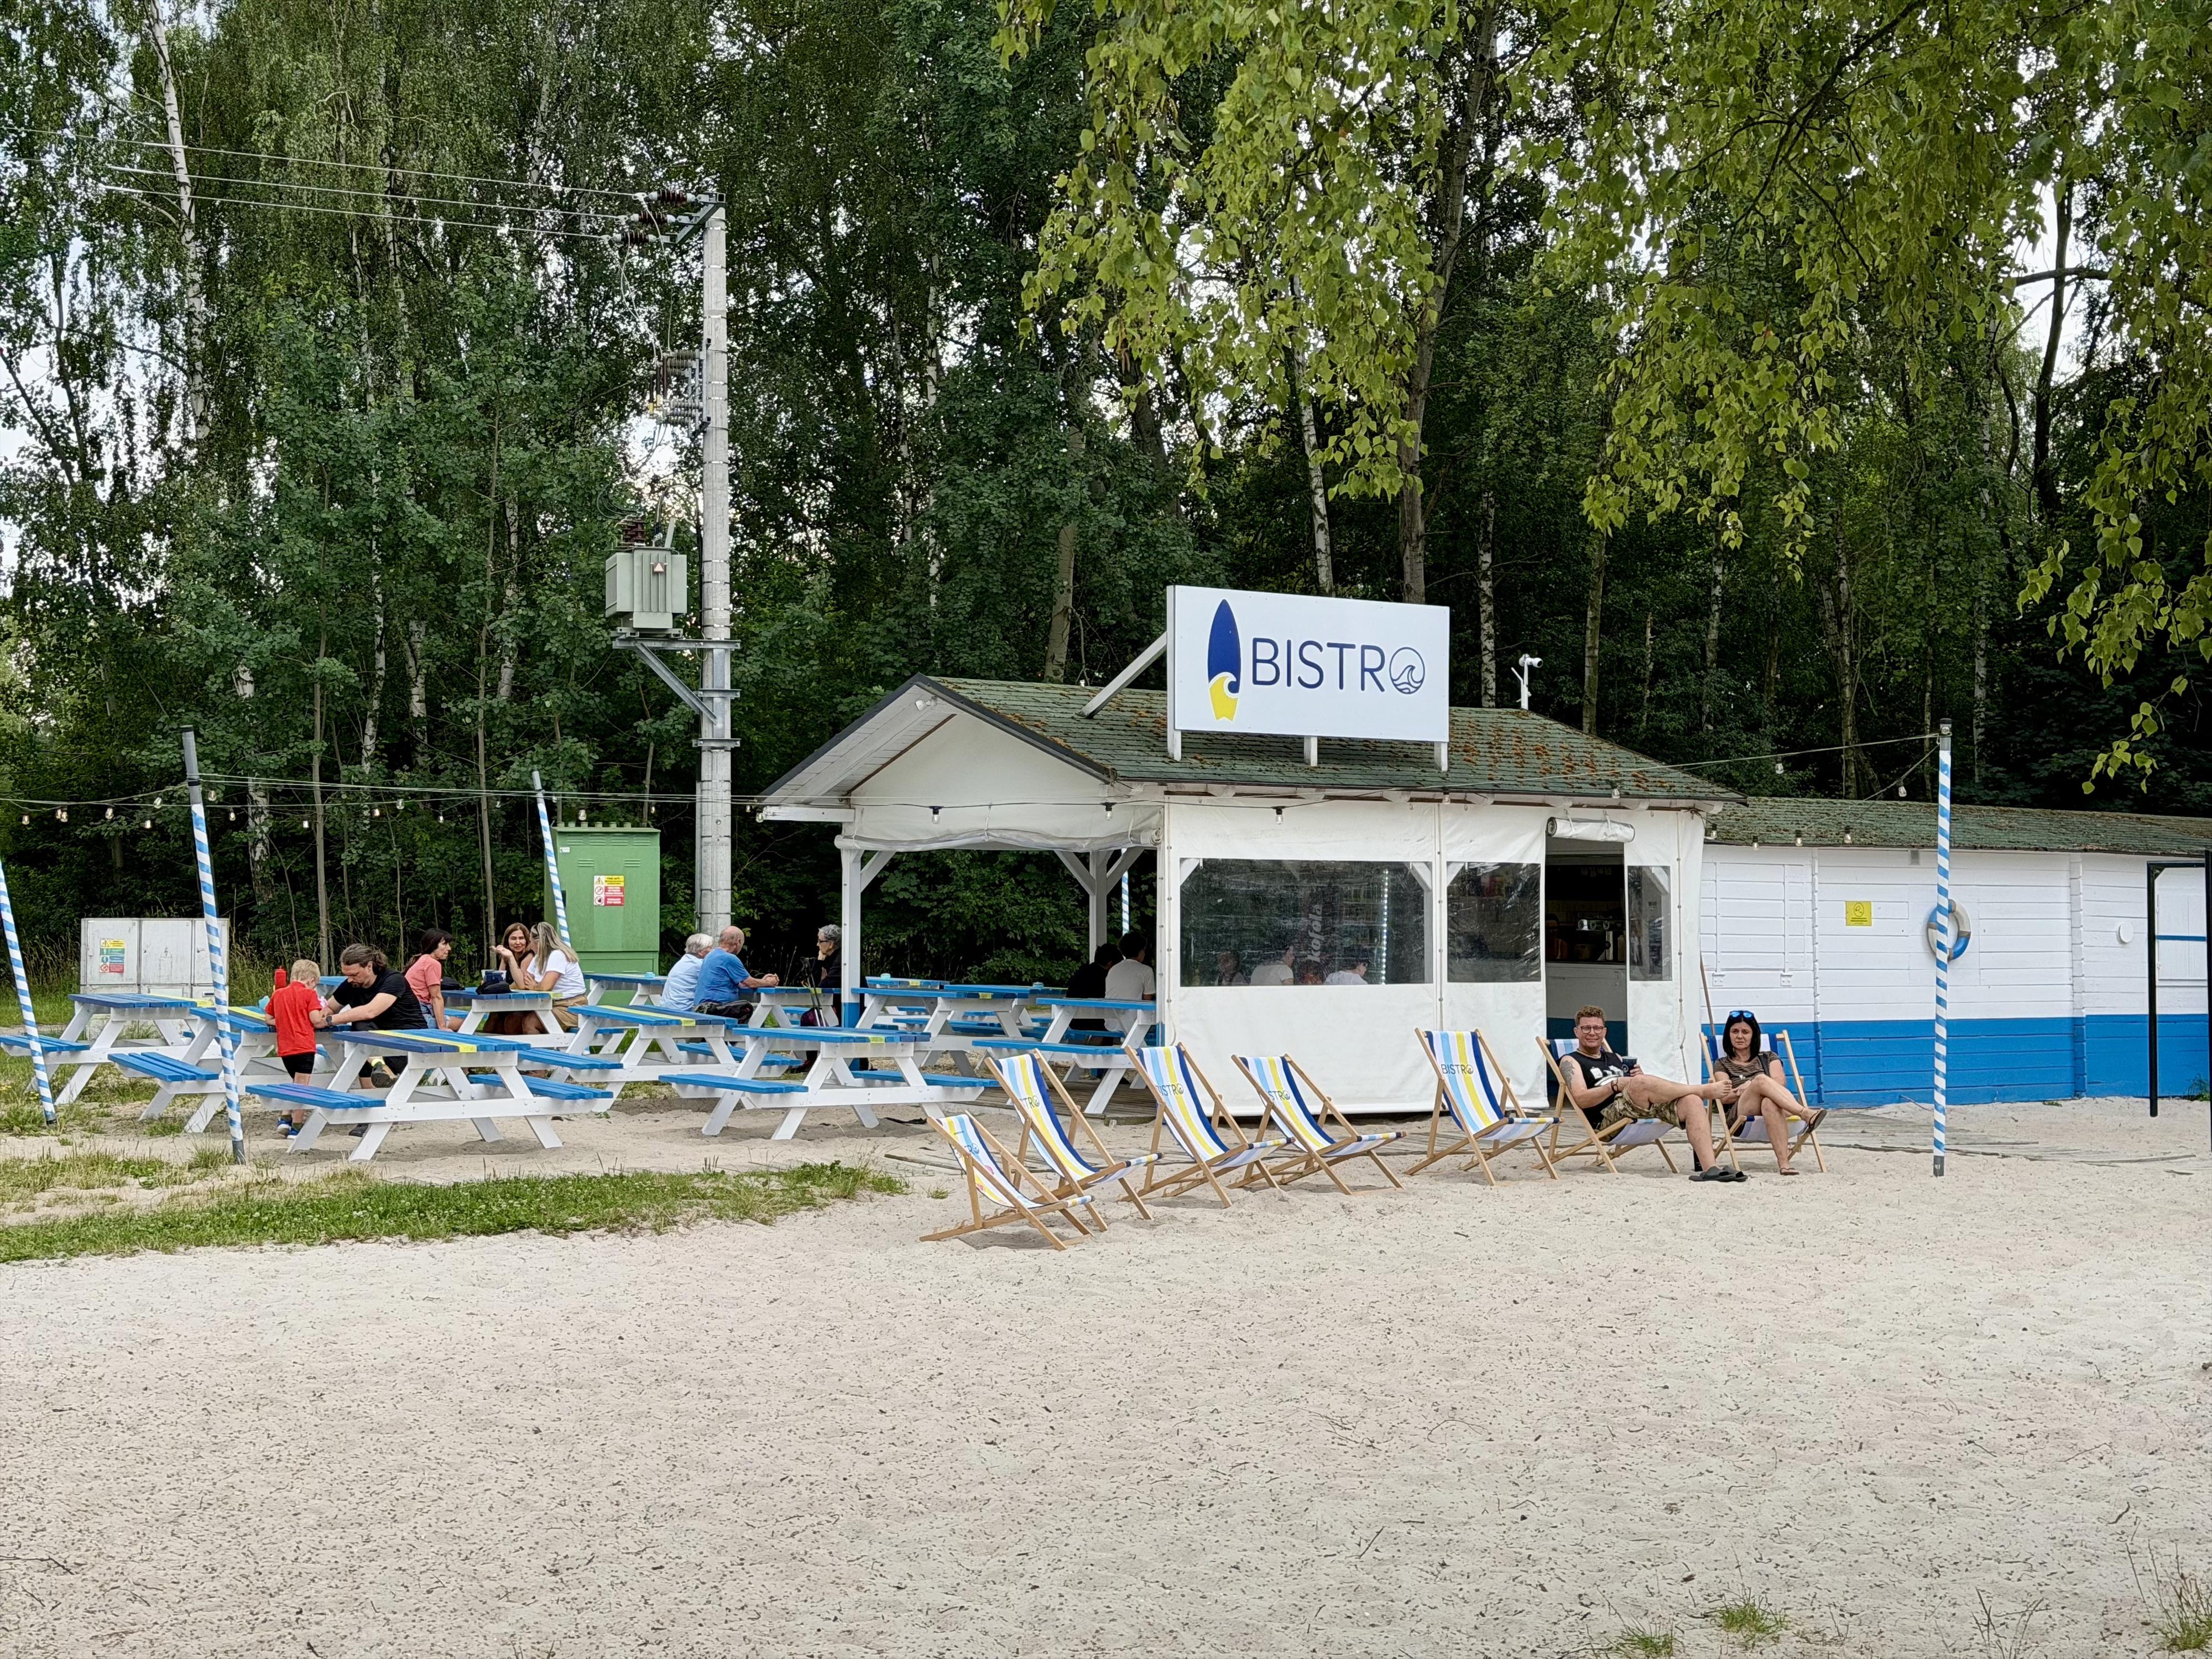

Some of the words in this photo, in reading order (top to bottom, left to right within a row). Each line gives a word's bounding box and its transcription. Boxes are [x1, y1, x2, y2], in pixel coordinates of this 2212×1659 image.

[1252, 637, 1426, 695] BISTRO
[1441, 1064, 1474, 1075] BISTRO
[1267, 1090, 1291, 1101] STRO
